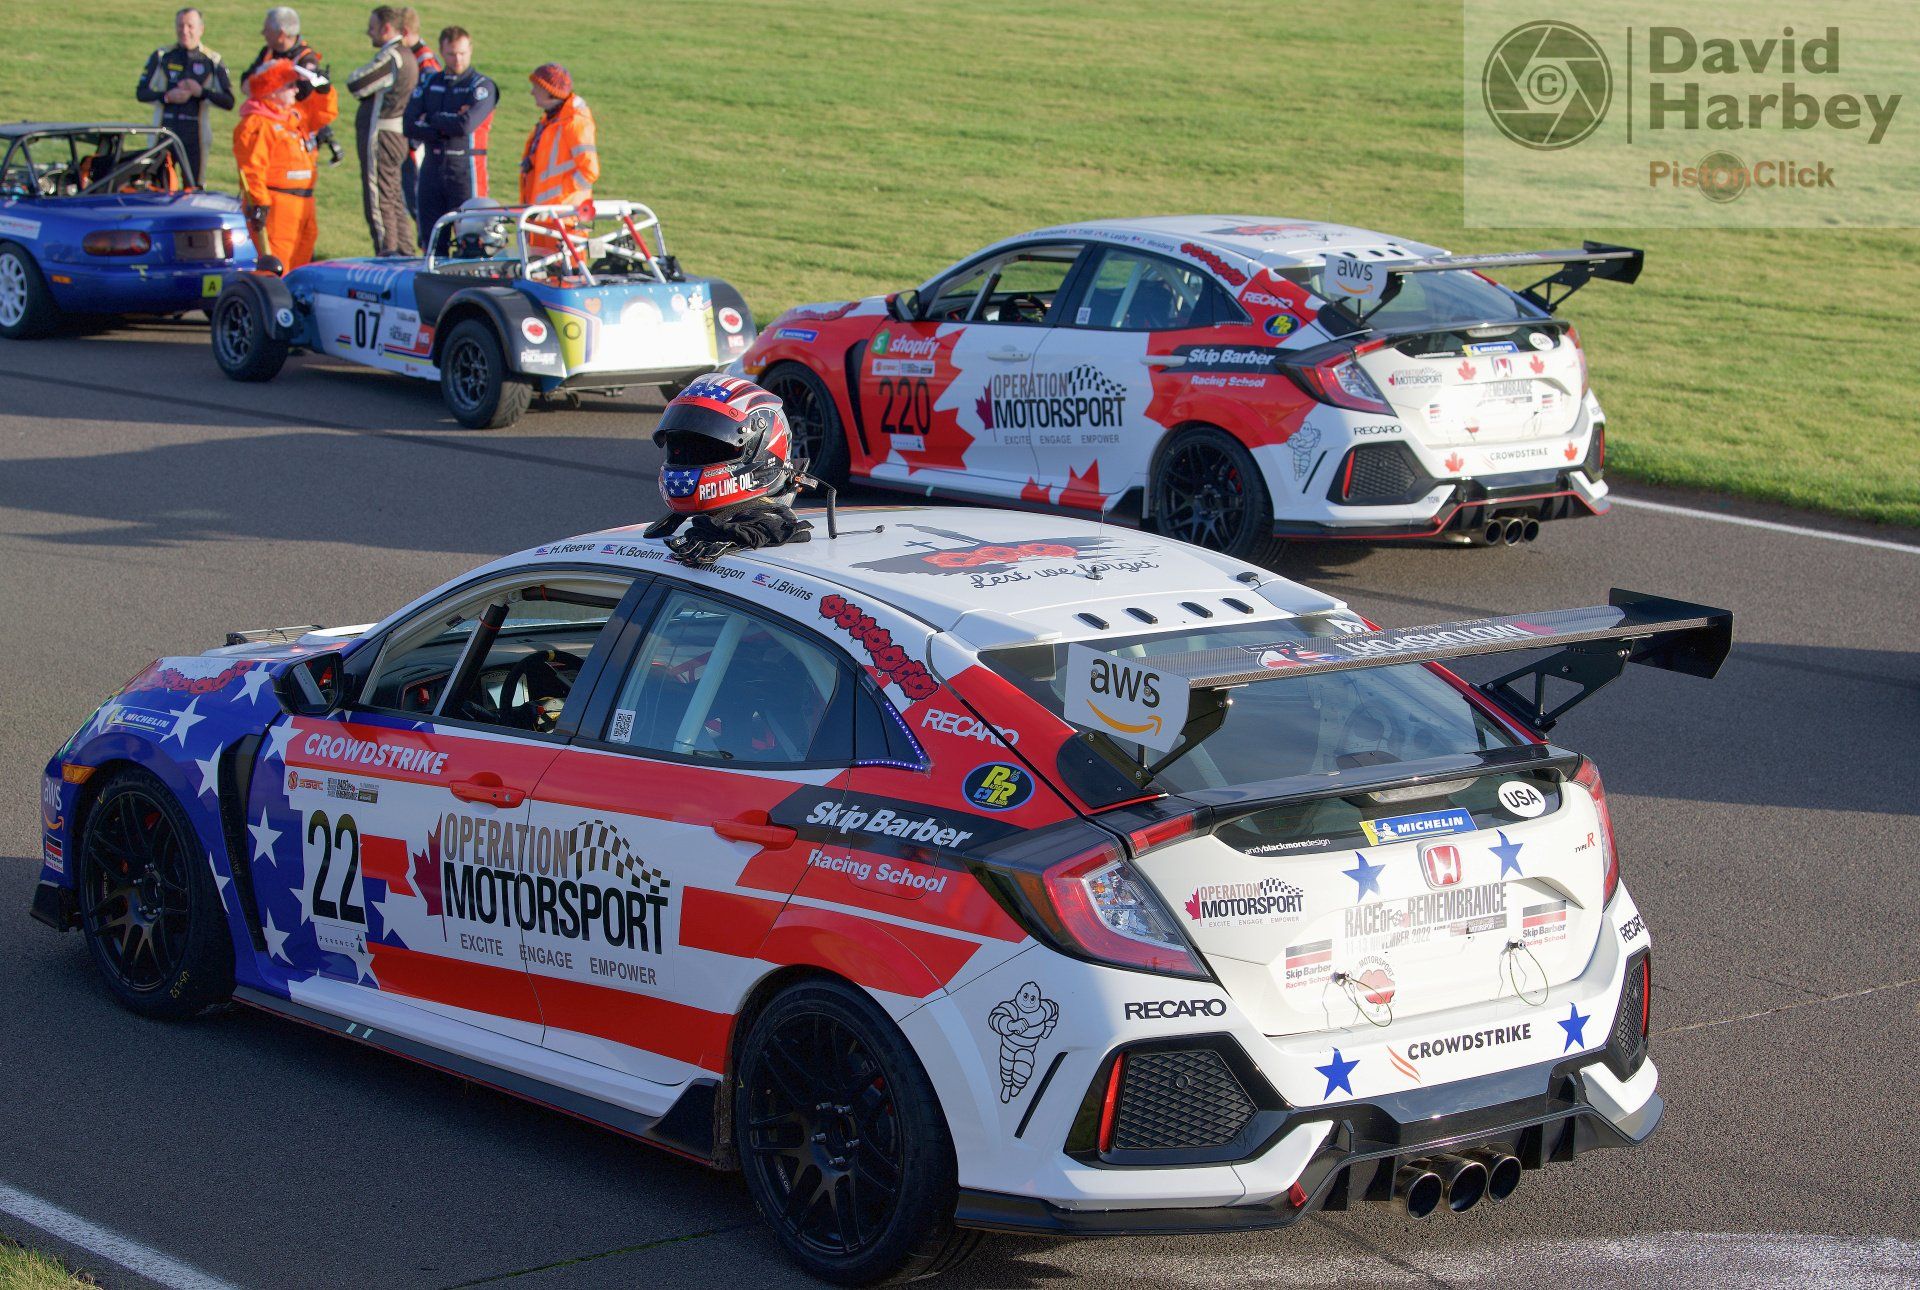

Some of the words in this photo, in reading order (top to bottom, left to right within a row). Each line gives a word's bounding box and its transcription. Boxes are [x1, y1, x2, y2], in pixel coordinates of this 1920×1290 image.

[1337, 259, 1373, 282] aws
[208, 281, 217, 292] A
[1242, 292, 1293, 310] RECARO
[355, 309, 381, 350] 07
[890, 334, 941, 360] shopify
[1188, 349, 1221, 365] Skip
[1220, 349, 1276, 365] Barber
[993, 373, 1069, 398] OPERATION
[1191, 375, 1227, 388] Racing
[1228, 376, 1266, 388] School
[878, 377, 931, 435] 220
[994, 397, 1126, 429] MOTORSPORT
[1005, 435, 1031, 445] EXCITE
[1040, 434, 1072, 445] ENGAGE
[1081, 434, 1120, 444] EMPOWER
[1353, 425, 1402, 435] RECARO
[1489, 447, 1548, 461] CROWDSTRIKE
[699, 482, 718, 501] RED
[718, 477, 738, 496] LINE
[550, 541, 595, 555] H.Reeve
[615, 544, 664, 561] K.Boehm
[767, 578, 814, 601] J.Bivins
[971, 570, 1031, 589] Lest
[1090, 658, 1161, 709] aws
[125, 712, 170, 729] MICHELIN
[920, 708, 1020, 748] RECARO
[304, 733, 449, 775] CROWDSTRIKE
[1503, 787, 1541, 808] USA
[806, 801, 869, 834] Skip
[863, 809, 973, 848] Barber
[1397, 816, 1464, 834] MICHELIN
[444, 812, 570, 879] OPERATION
[308, 809, 366, 925] 22
[807, 848, 872, 881] Racing
[875, 863, 947, 893] School
[1200, 883, 1261, 900] OPERATION
[443, 861, 669, 955] MOTORSPORT
[1201, 894, 1304, 919] MOTORSPORT
[1345, 903, 1381, 939] RACE
[1407, 882, 1507, 928] REMEMBRANCE
[1523, 927, 1539, 938] Skip
[1539, 923, 1567, 935] Barber
[460, 933, 504, 957] EXCITE
[519, 943, 574, 970] ENGAGE
[589, 957, 657, 986] EMPOWER
[1286, 969, 1303, 980] Skip
[1303, 964, 1332, 976] Barber
[1124, 998, 1227, 1021] RECARO
[1408, 1023, 1531, 1061] CROWDSTRIKE
